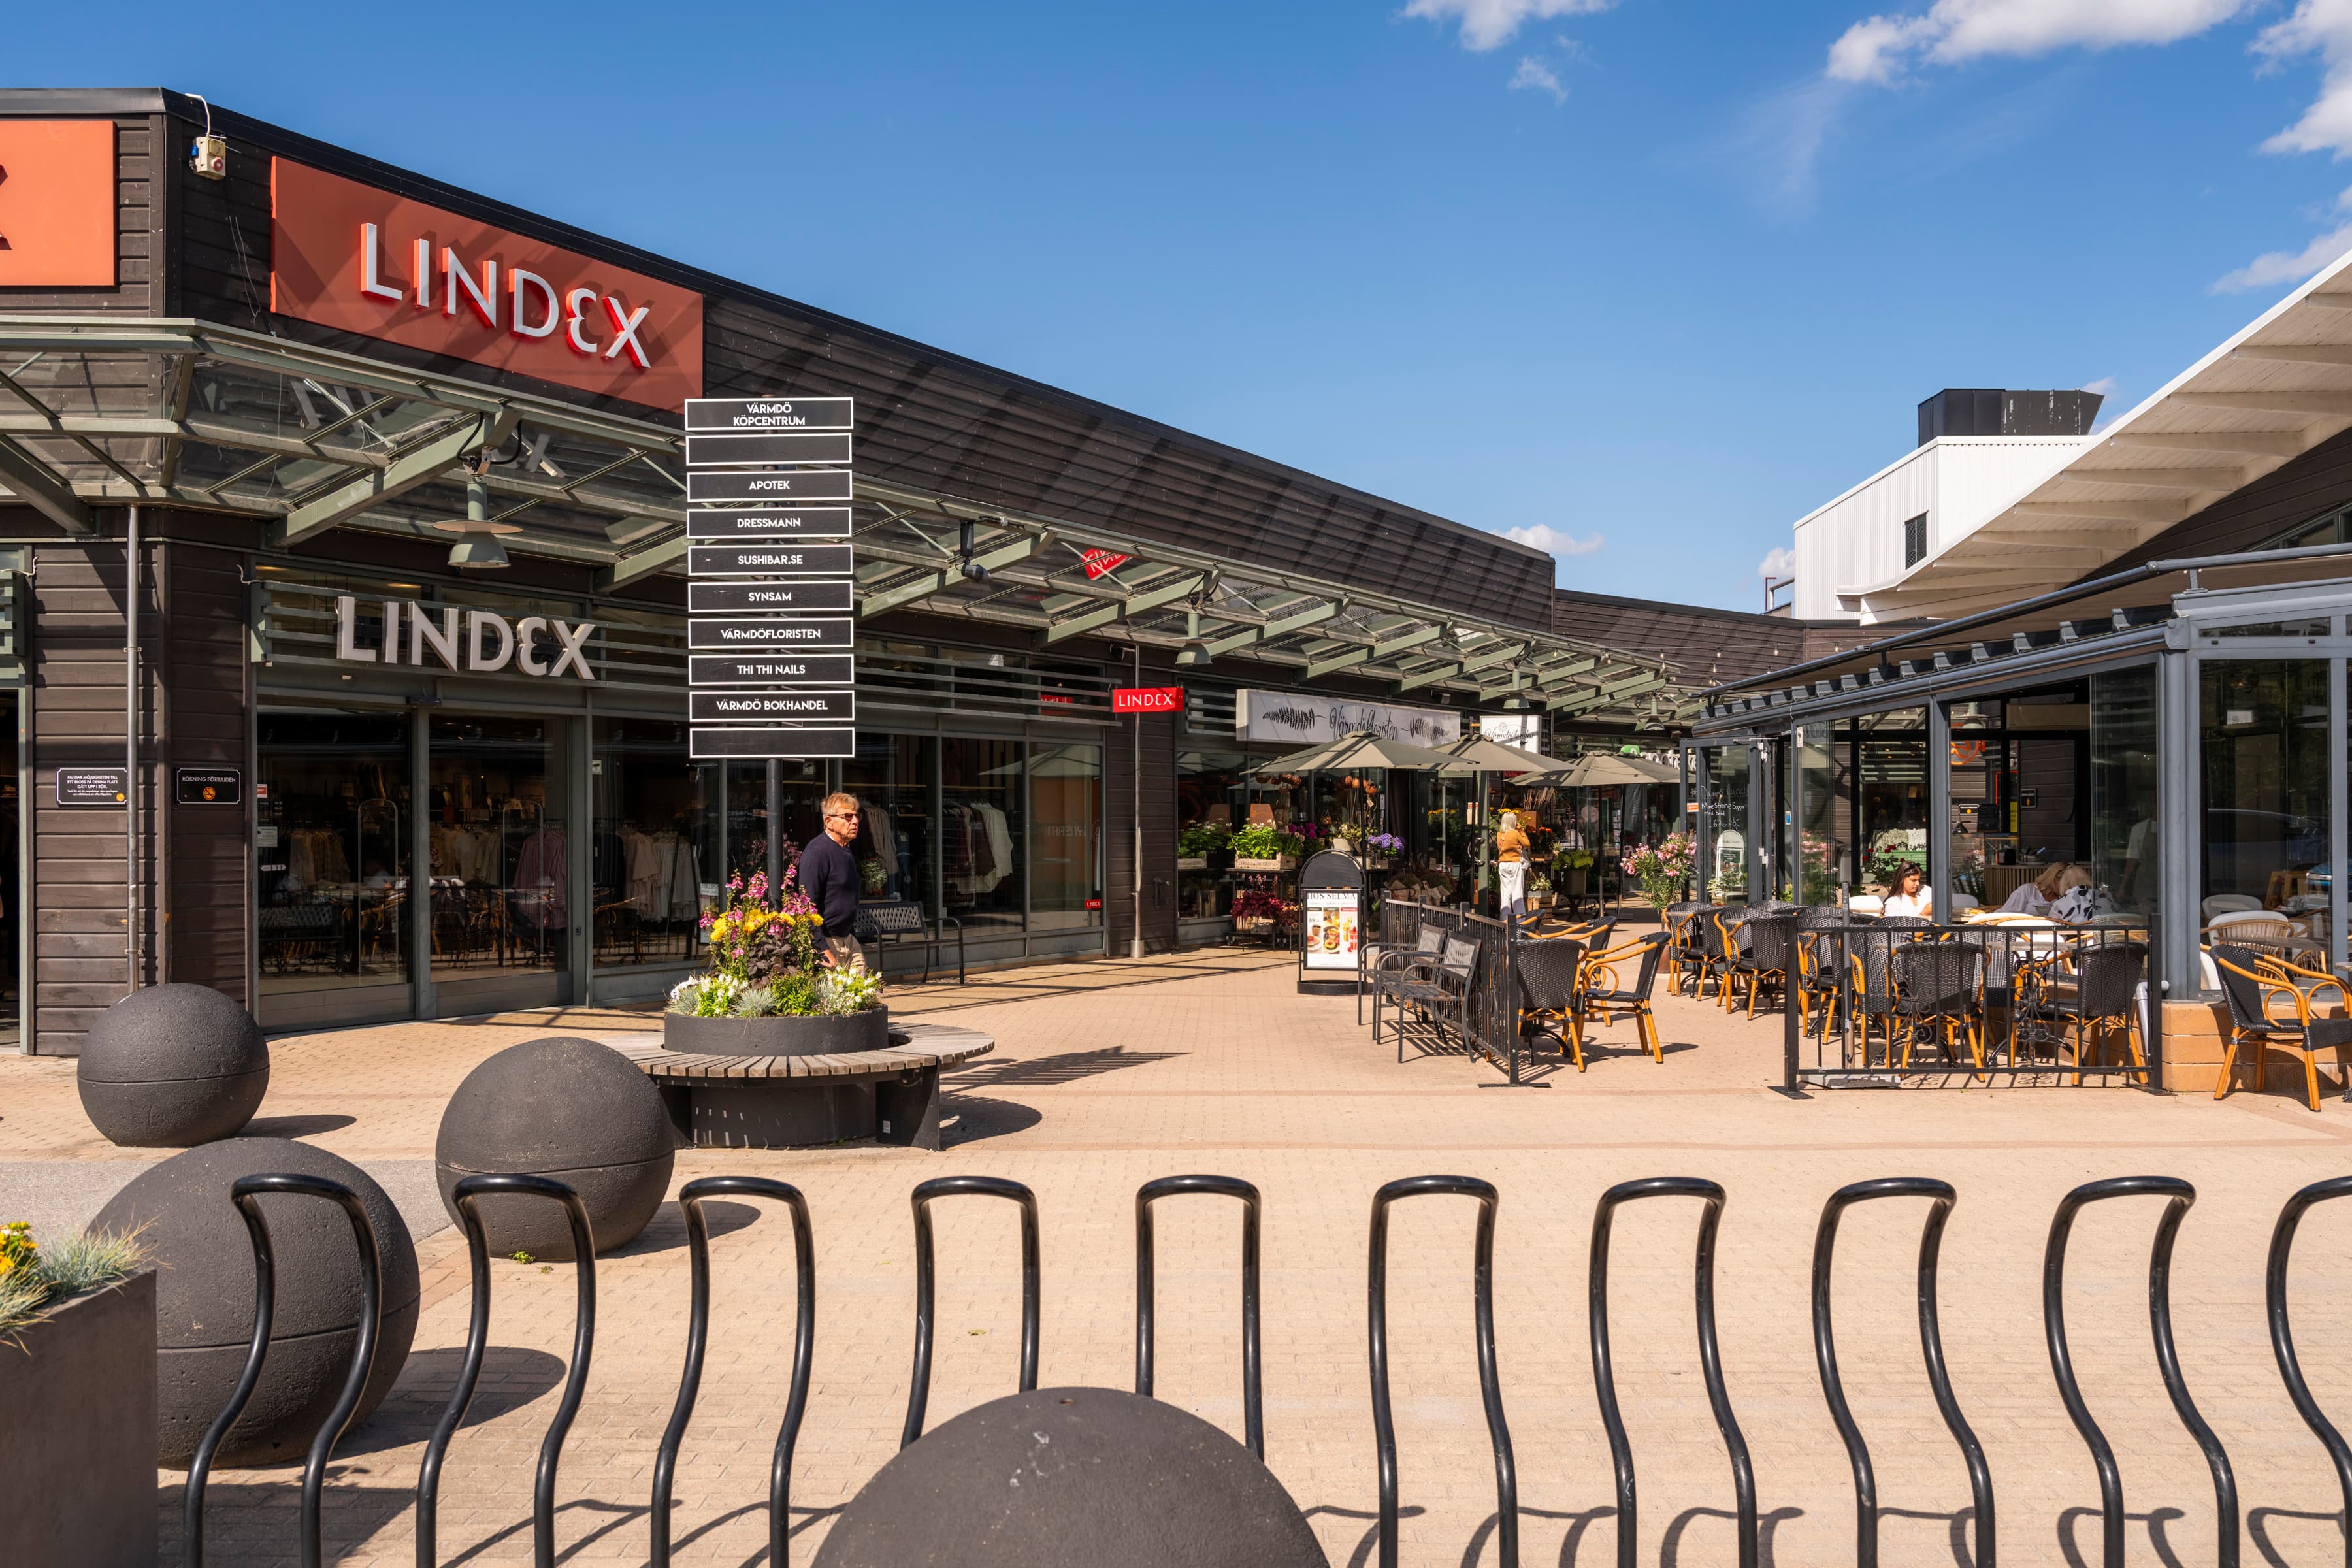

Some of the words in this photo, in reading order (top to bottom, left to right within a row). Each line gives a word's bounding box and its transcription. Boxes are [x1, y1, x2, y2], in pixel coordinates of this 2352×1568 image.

[361, 222, 651, 368] LINDEX
[746, 402, 792, 414] VÄRMDÖ
[733, 415, 805, 427] KÖPCENTRUM
[749, 480, 791, 491] APOTEK
[737, 517, 801, 528] DRESSMANN
[738, 555, 803, 565] SUSHIBAR.SE
[749, 592, 792, 601] SYNSAM
[336, 596, 596, 680] LINDEX
[721, 628, 821, 639] VÄRMDÖFLORISTEN
[737, 665, 753, 675] THI
[756, 665, 772, 674] THI
[775, 664, 806, 674] NAILS
[716, 699, 762, 710] VÄRMDÖ
[764, 700, 828, 710] BOKHANDEL
[1119, 693, 1173, 707] LINDEX
